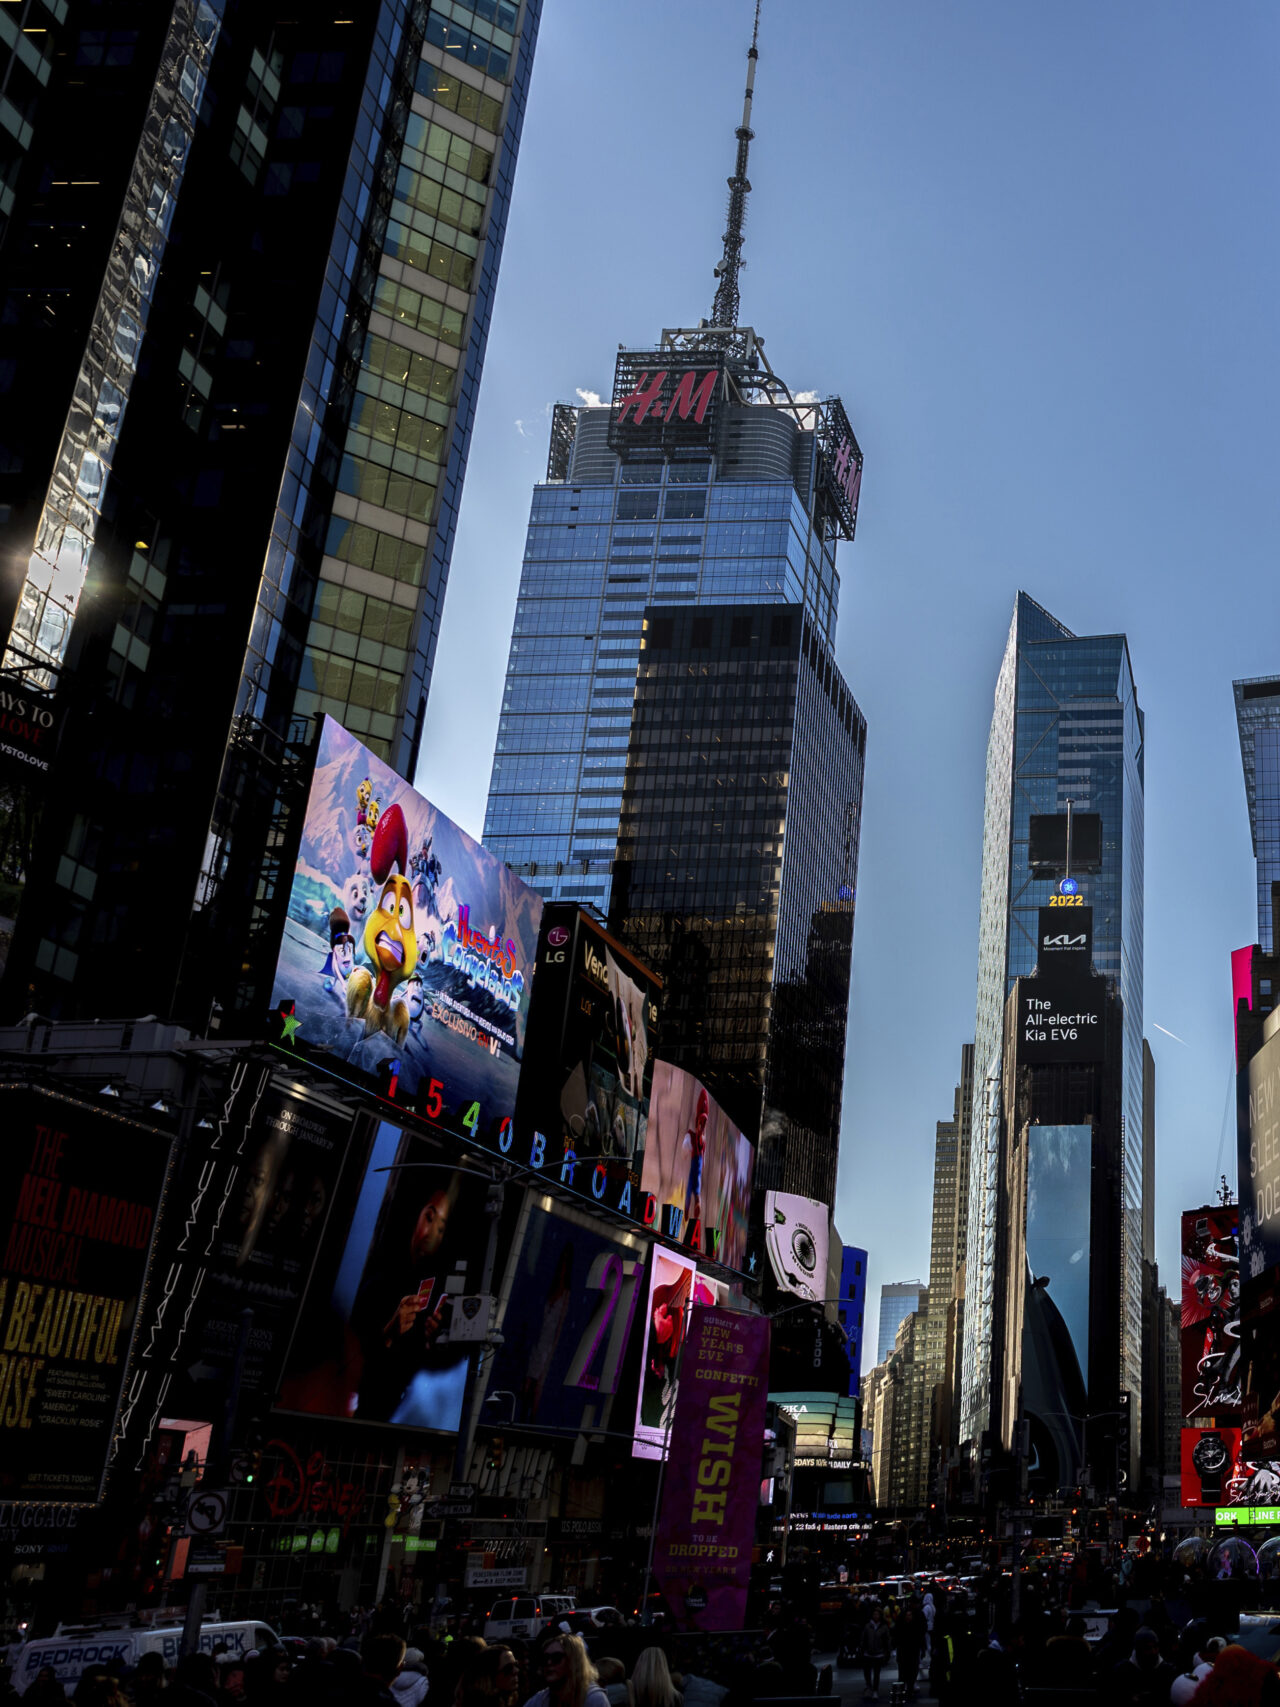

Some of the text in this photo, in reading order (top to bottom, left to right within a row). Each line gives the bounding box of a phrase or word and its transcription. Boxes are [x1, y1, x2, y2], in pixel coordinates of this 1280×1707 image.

[616, 369, 719, 425] H&M
[834, 436, 862, 515] H&M
[32, 704, 55, 729] TO
[0, 713, 46, 747] LOVE
[1049, 894, 1084, 907] 2022
[1043, 934, 1087, 946] KIA
[545, 950, 566, 964] LG
[1026, 998, 1051, 1011] The
[432, 1002, 477, 1042] EXCLUSIVO
[477, 1031, 489, 1049] EN
[1025, 1012, 1098, 1026] All-electric
[1025, 1029, 1078, 1042] Kia EV6
[1250, 1072, 1275, 1126] NEW
[29, 1122, 71, 1180] THE
[14, 1172, 153, 1250] NEIL DIAMOND
[3, 1220, 84, 1286] MUSICAL
[3, 1280, 126, 1366] BEAUTIFUL
[702, 1325, 731, 1339] NEW
[698, 1348, 724, 1363] EVE
[701, 1337, 744, 1354] YEAR'S
[696, 1368, 760, 1388] CONFETTI
[690, 1391, 742, 1527] WISH
[0, 1506, 80, 1529] LUGGAGE
[453, 1506, 468, 1514] WAY
[692, 1534, 718, 1543] TO BE
[14, 1544, 44, 1554] SONY
[668, 1544, 739, 1558] DROPPED
[25, 1644, 130, 1671] BEDROCK
